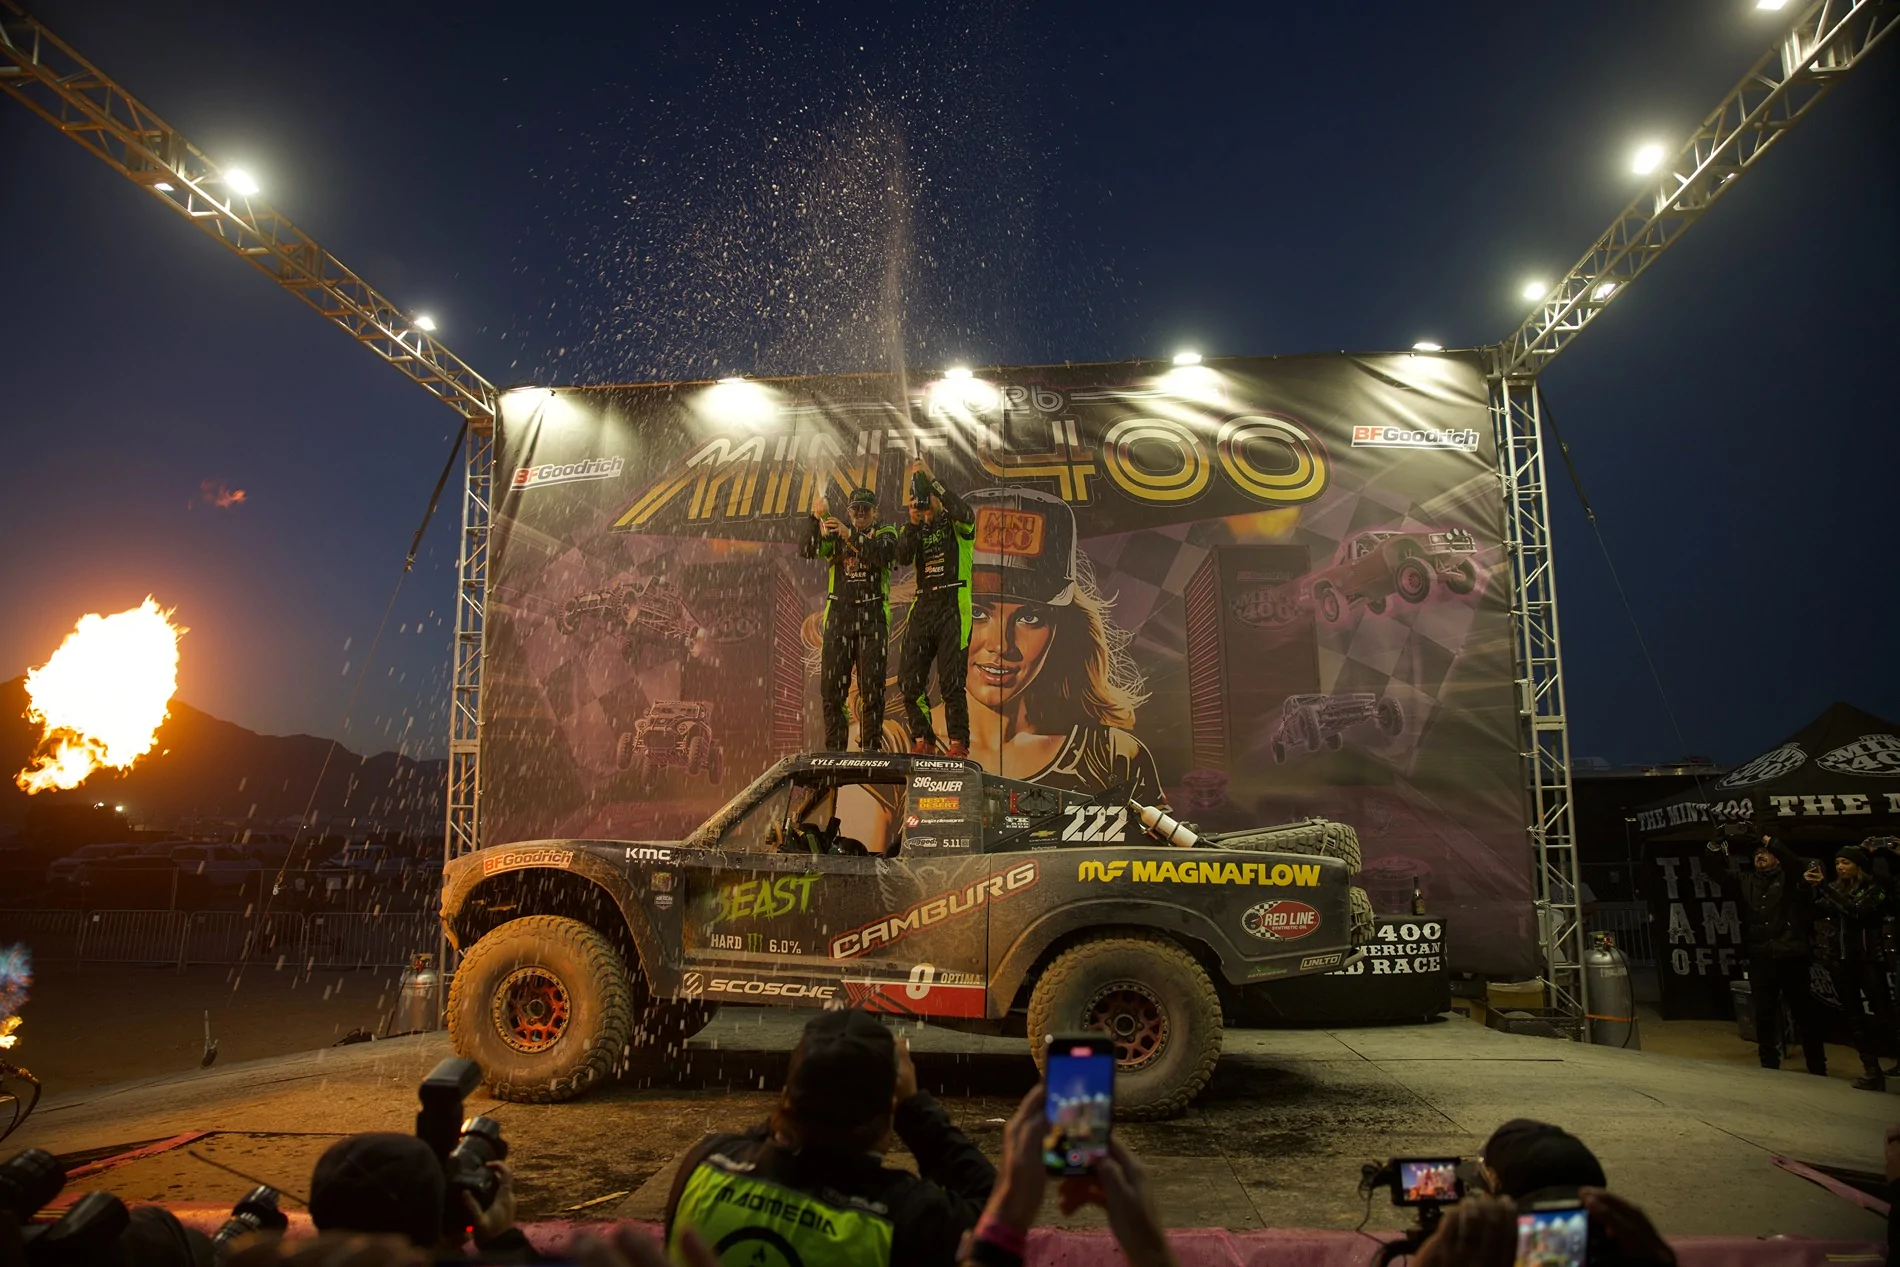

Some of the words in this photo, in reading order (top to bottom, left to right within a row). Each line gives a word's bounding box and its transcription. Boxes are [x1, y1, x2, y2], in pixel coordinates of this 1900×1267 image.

[1354, 427, 1478, 445] BFGoodrich
[513, 458, 624, 485] BFGoodrich
[612, 431, 948, 530] MINT
[978, 414, 1327, 501] 400
[984, 512, 1036, 534] MINT
[983, 528, 1033, 551] 400
[836, 759, 891, 767] JERGENSEN
[913, 776, 931, 788] SIG
[928, 780, 963, 792] SAUER
[1637, 811, 1666, 832] THE
[1666, 801, 1711, 827] MINT
[1710, 797, 1754, 821] 400
[1769, 795, 1872, 817] THE
[1061, 805, 1128, 842] 222
[943, 838, 960, 848] 5.11
[484, 849, 572, 872] BFGoodrich
[1132, 861, 1321, 887] MAGNAFLOW
[709, 869, 826, 923] BEAST
[831, 862, 1037, 960] CAMBURG
[1265, 913, 1288, 926] RED
[1289, 912, 1316, 925] LINE
[1377, 922, 1442, 942] 400
[711, 934, 742, 949] HARD
[769, 939, 802, 954] 6.0%
[1371, 956, 1441, 975] RACE
[707, 979, 837, 999] SCOSCHE
[940, 972, 983, 985] OPTIMA
